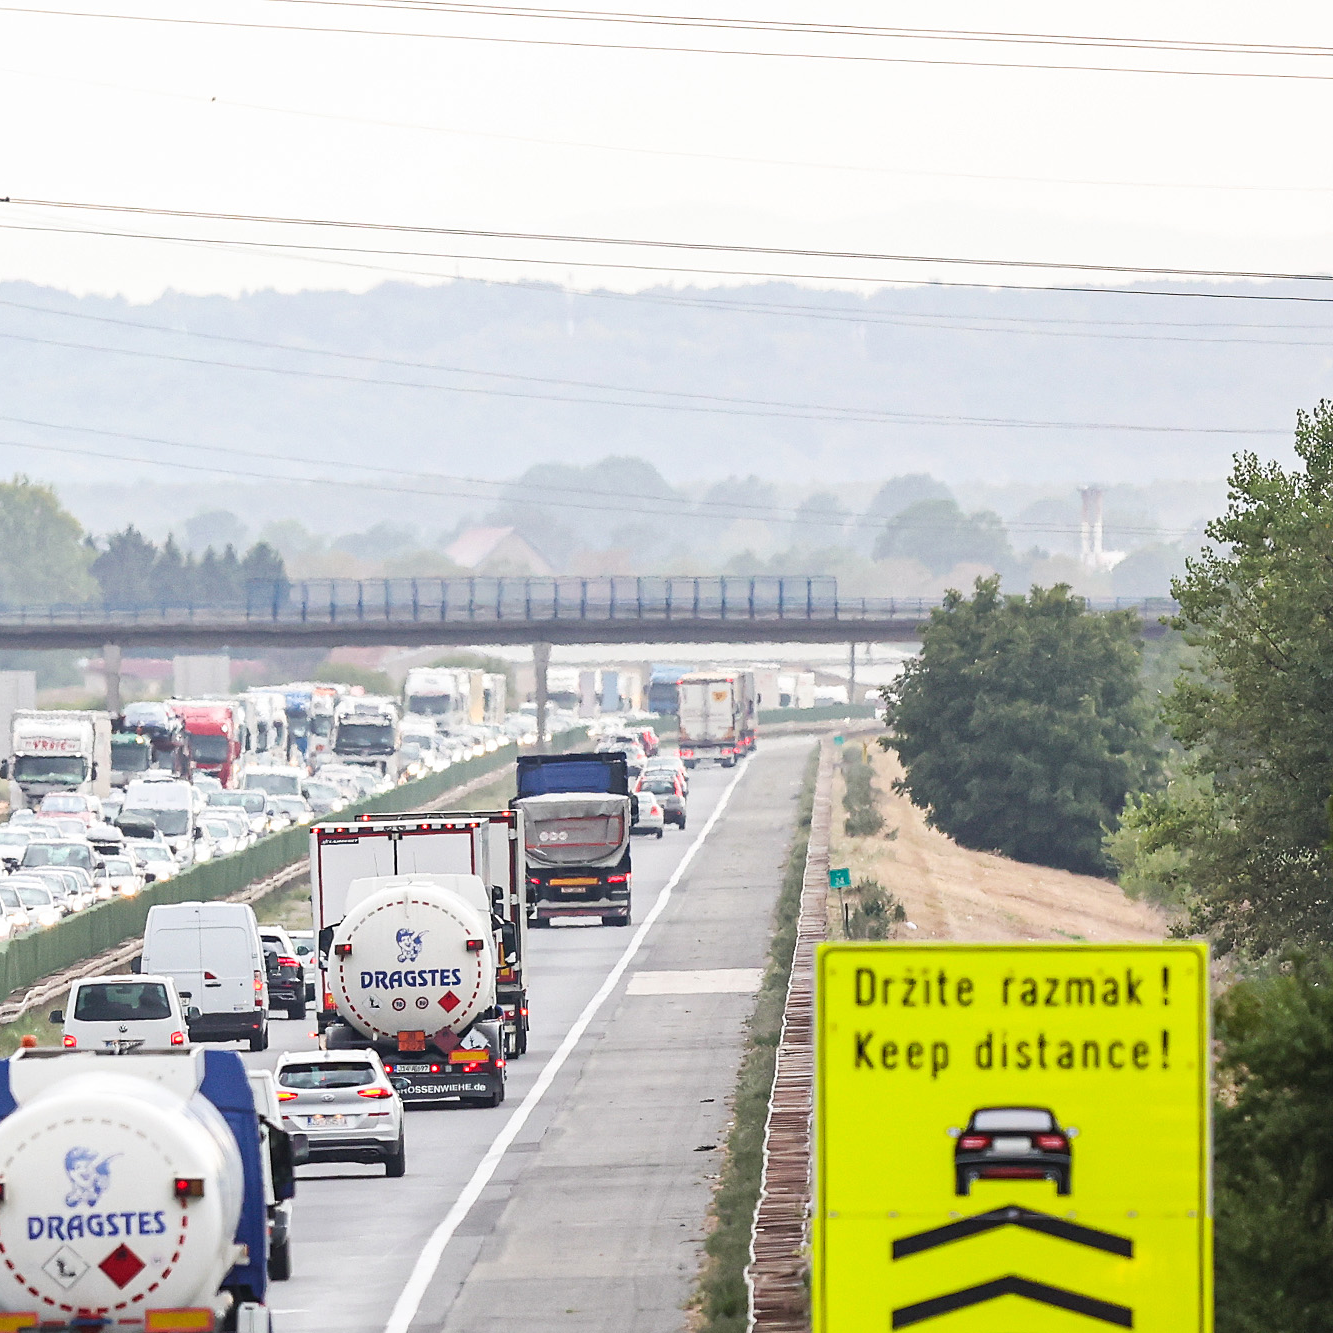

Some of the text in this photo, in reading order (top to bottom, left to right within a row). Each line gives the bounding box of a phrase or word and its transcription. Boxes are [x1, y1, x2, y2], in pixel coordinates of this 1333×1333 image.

[360, 968, 462, 990] DRAGSTES
[854, 966, 975, 1007] Držite
[1002, 966, 1144, 1007] razmak
[854, 1030, 949, 1080] Keep
[27, 1210, 167, 1241] DRAGSTES
